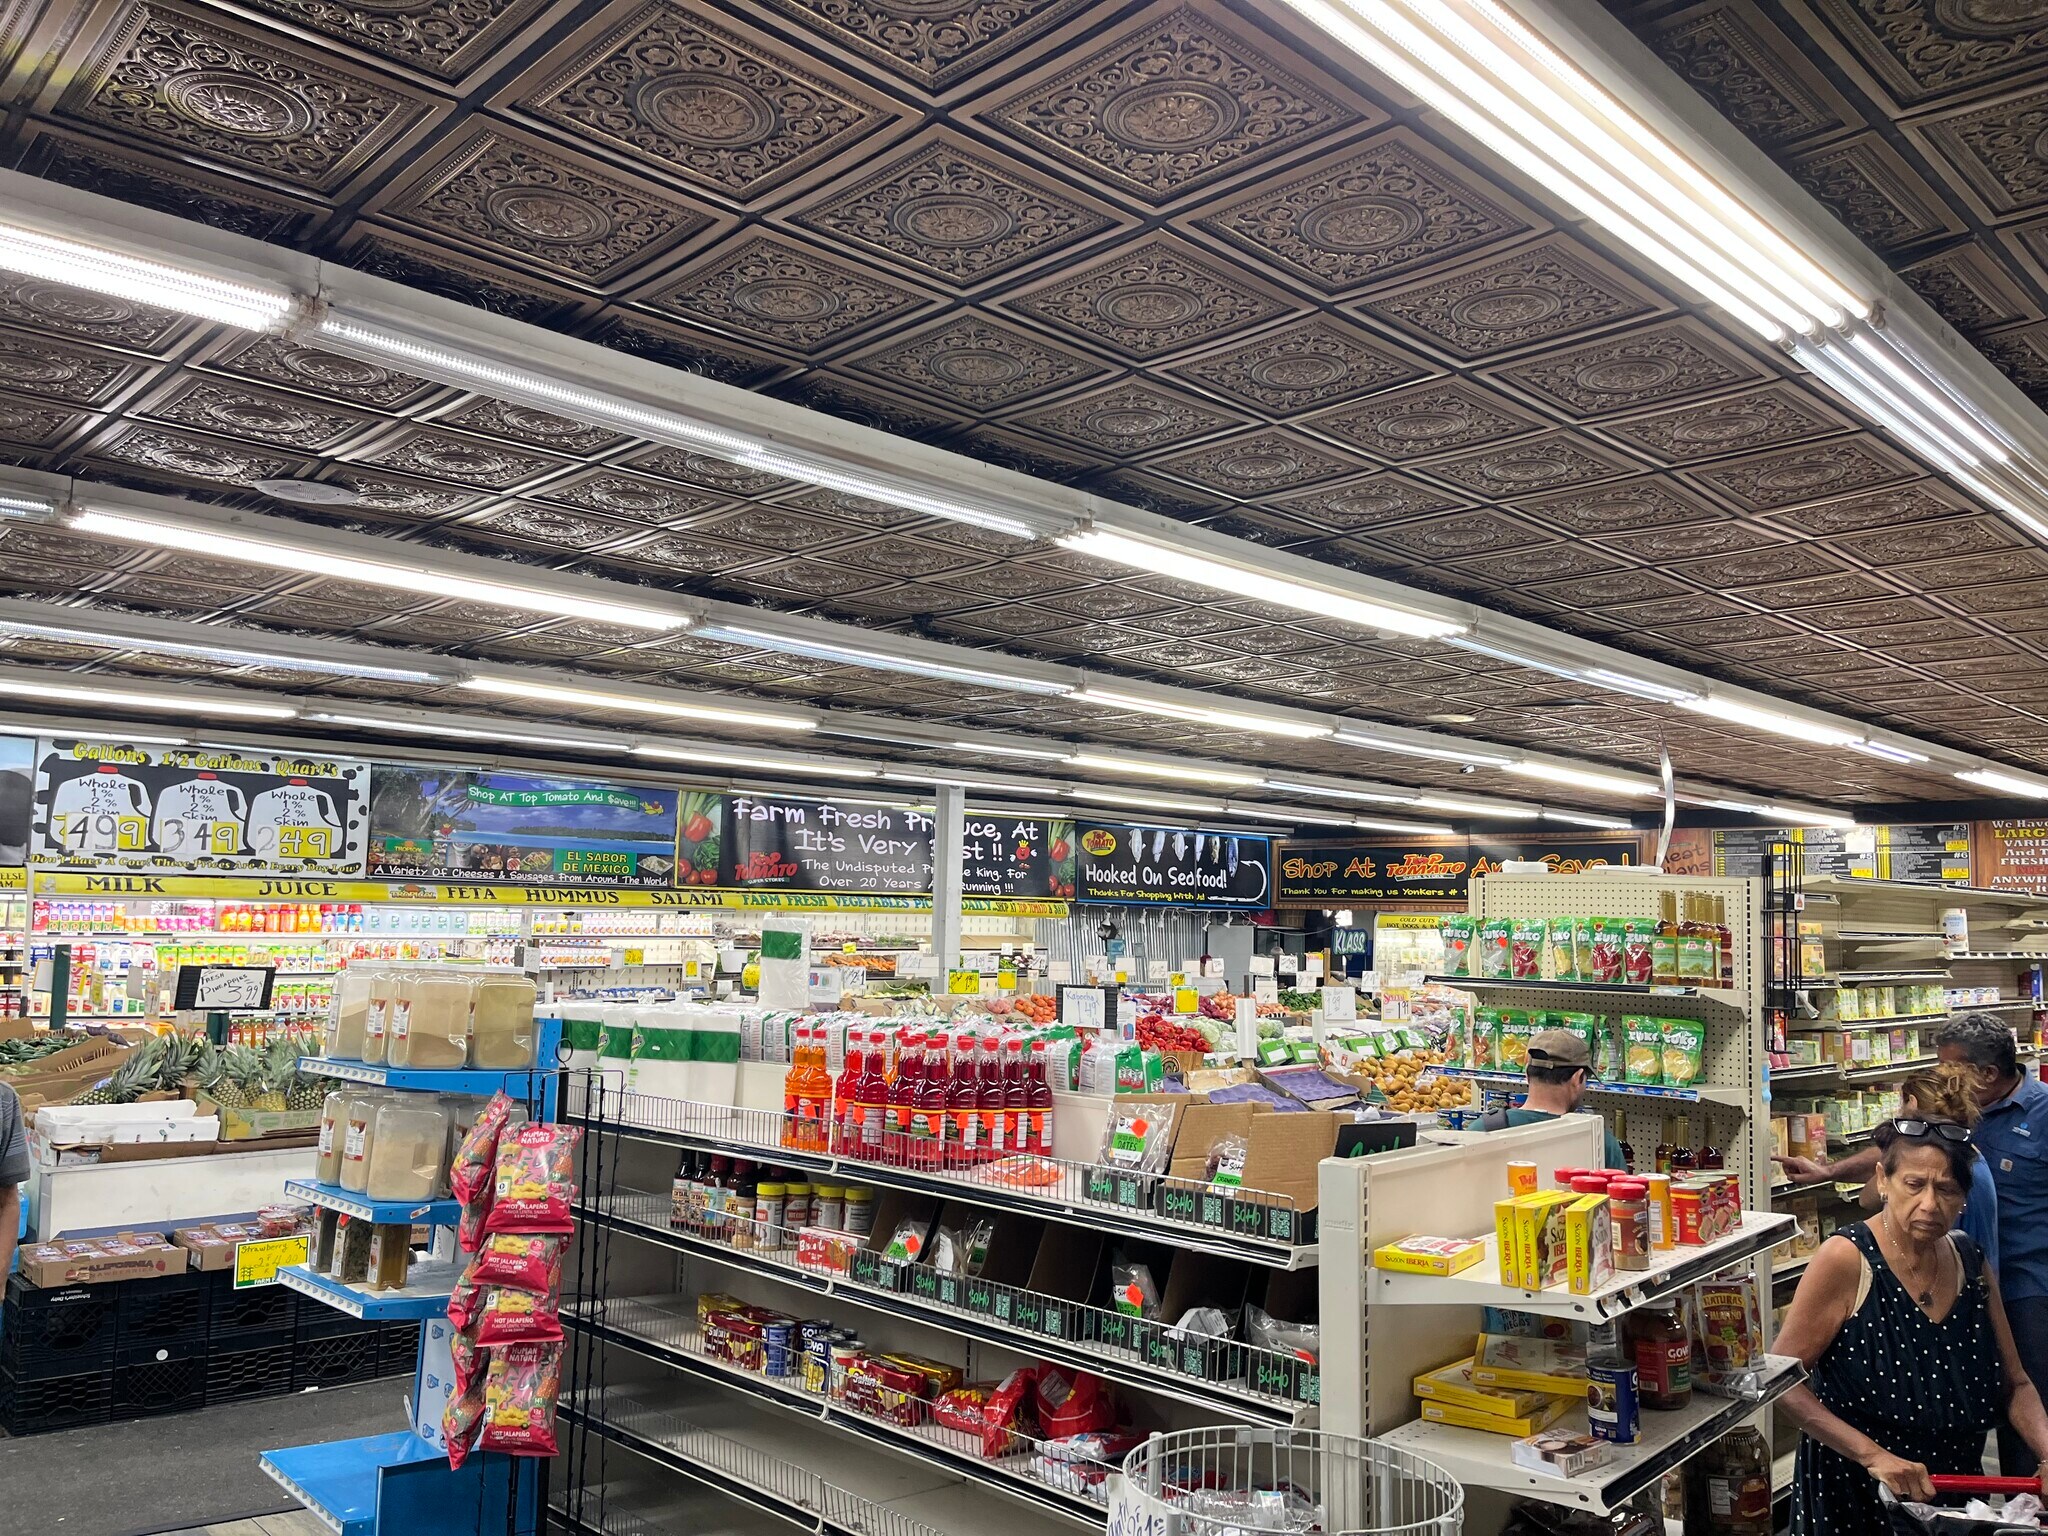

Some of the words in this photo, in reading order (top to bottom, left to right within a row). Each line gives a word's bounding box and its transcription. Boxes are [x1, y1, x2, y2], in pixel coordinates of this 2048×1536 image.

[73, 742, 147, 764] Gallons
[162, 752, 190, 767] 1/2
[194, 753, 263, 772] Gallons
[275, 758, 339, 777] Quart's
[79, 778, 127, 791] Whole
[180, 785, 225, 796] Whole
[271, 791, 316, 803] Whole
[469, 787, 496, 804] Shop
[519, 793, 538, 806] Top
[542, 792, 580, 802] Tomato
[585, 792, 604, 802] And
[182, 812, 218, 822] Skim
[274, 817, 309, 827] Skim
[732, 798, 805, 824] Farm
[817, 804, 891, 830] Fresh
[1011, 820, 1039, 841] At
[1992, 820, 2012, 828] We
[794, 828, 846, 852] It's
[857, 833, 918, 856] Very
[1086, 838, 1114, 848] TOMATO
[567, 851, 582, 861] EL
[586, 852, 628, 863] SABOR
[1403, 853, 1444, 866] TOP
[2005, 848, 2035, 856] And
[31, 853, 65, 865] Don't
[69, 855, 103, 867] Have
[193, 859, 231, 871] Prices
[269, 862, 304, 873] Every
[563, 862, 579, 872] DE
[583, 863, 630, 875] MEXICO
[801, 859, 829, 871] The
[836, 860, 915, 877] Undisputed
[1007, 868, 1027, 879] For
[1344, 856, 1376, 879] At
[1386, 861, 1467, 877] TOMATO
[374, 867, 385, 875] A
[389, 866, 428, 877] Variety
[452, 869, 495, 879] Cheeses
[509, 871, 554, 884] Sausages
[558, 873, 582, 882] From
[586, 874, 618, 884] Around
[622, 875, 640, 885] The
[643, 876, 668, 887] World
[735, 863, 798, 881] TOMATO
[1085, 863, 1137, 885] Hooked
[1142, 866, 1163, 886] On
[1167, 867, 1228, 889] Seafood!
[85, 875, 166, 893] MILK
[259, 880, 338, 896] JUICE
[819, 876, 853, 888] Over
[860, 877, 877, 888] 20
[884, 878, 922, 889] Years
[446, 886, 498, 900] FETA
[525, 889, 620, 904] HUMMUS
[651, 892, 724, 906] SALAMI
[1087, 888, 1119, 897] Thanks
[1120, 889, 1135, 898] For
[1136, 889, 1172, 902] Shopping
[1173, 891, 1194, 900] With
[1282, 887, 1311, 896] Thank
[1314, 887, 1328, 896] You
[1331, 887, 1347, 896] For
[1351, 888, 1383, 898] making
[1387, 889, 1399, 897] us
[743, 893, 782, 907] FARM
[787, 894, 829, 907] FRESH
[834, 896, 910, 909] VEGETABLES
[962, 898, 991, 911] DAILY
[1018, 902, 1028, 913] TOP
[1029, 903, 1048, 914] TOMATO
[1334, 931, 1366, 953] KLASS
[1117, 1140, 1138, 1152] DATES
[240, 1243, 288, 1254] Strawberry
[1503, 1240, 1513, 1268] IBERIA
[488, 1256, 500, 1264] HOT
[1406, 1257, 1430, 1269] IBERIA
[1524, 1243, 1532, 1271] IBERIA
[1575, 1246, 1583, 1274] IBERIA
